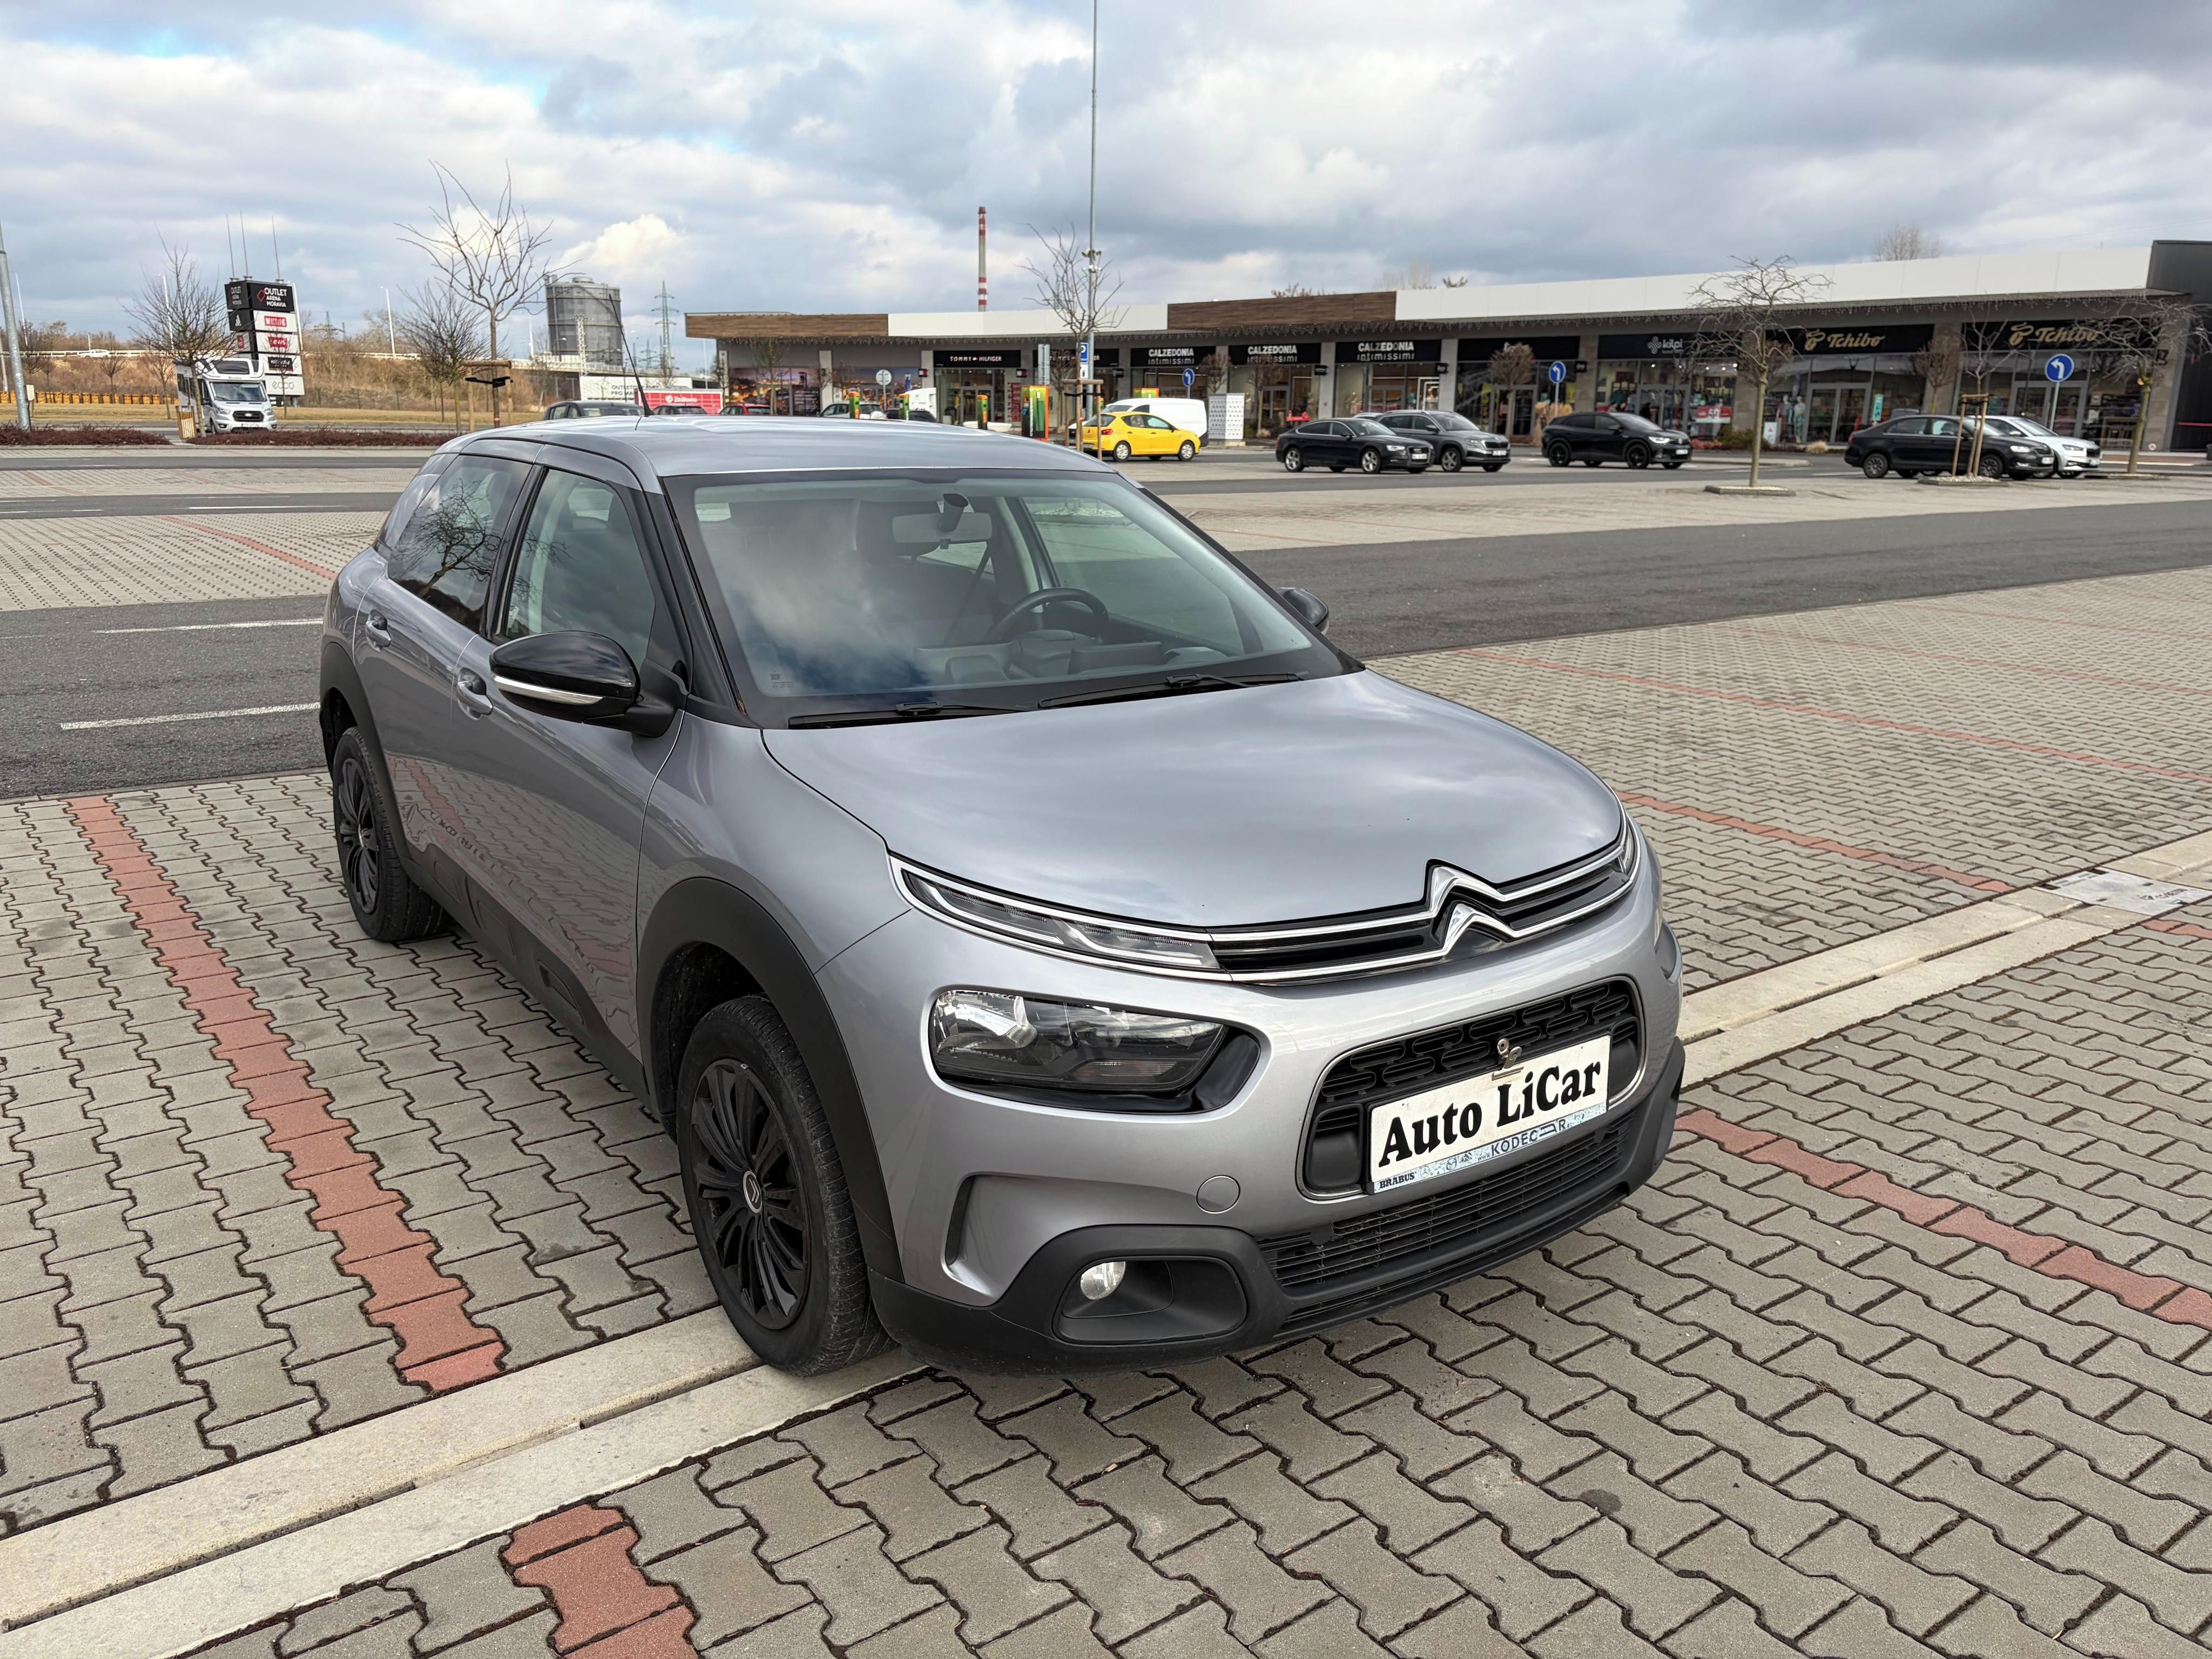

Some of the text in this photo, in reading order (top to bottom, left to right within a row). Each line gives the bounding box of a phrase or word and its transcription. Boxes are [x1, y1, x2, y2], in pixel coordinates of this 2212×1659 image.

[264, 287, 287, 296] OUTLET
[1662, 339, 1683, 349] kilpi
[1827, 332, 1885, 348] Tchibo
[1247, 345, 1297, 355] CALZEDONIA
[1358, 341, 1414, 352] CALZEDONIA
[1148, 348, 1194, 357] CALZEDONIA
[1357, 353, 1415, 361] intimissimi
[1379, 1061, 1601, 1168] Auto LiCar
[1379, 1172, 1415, 1189] BRABUS
